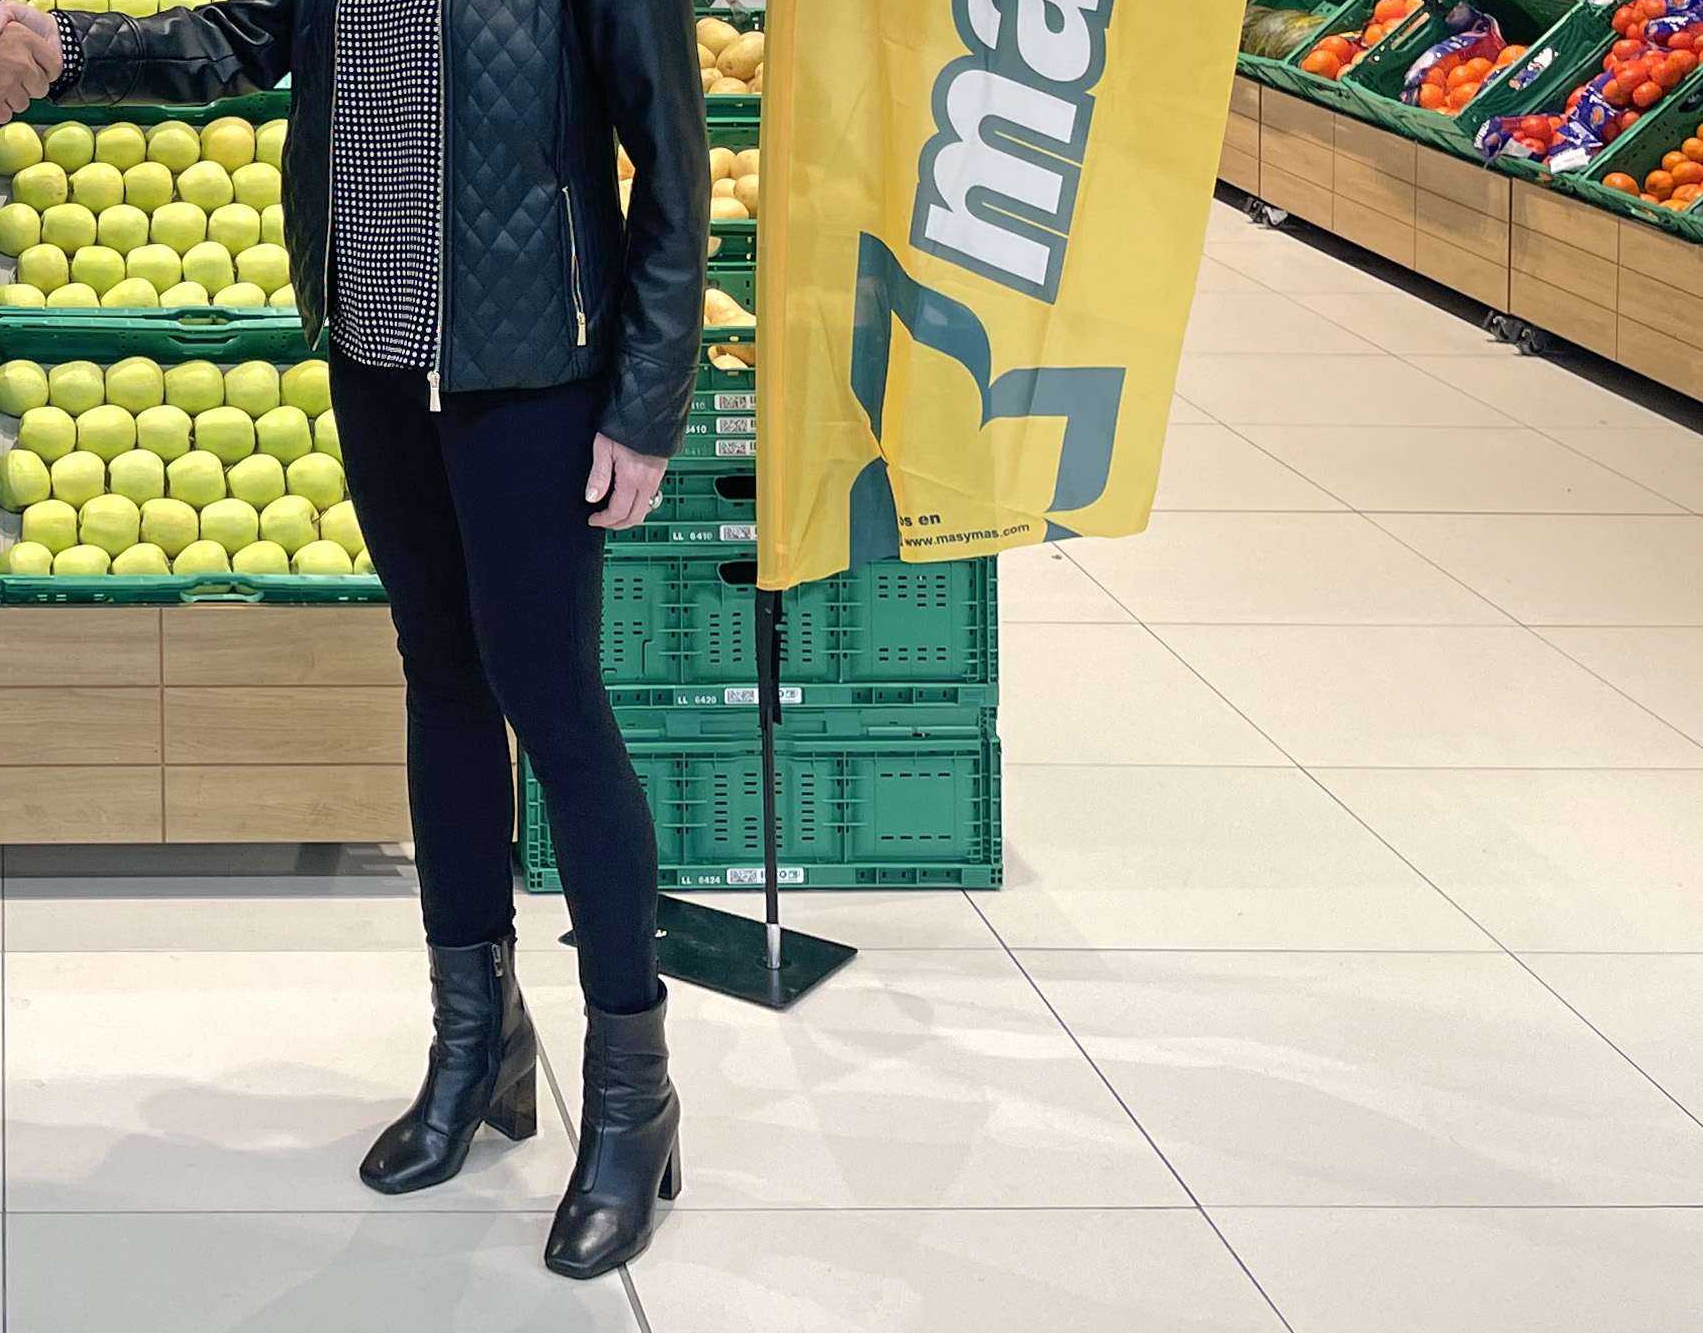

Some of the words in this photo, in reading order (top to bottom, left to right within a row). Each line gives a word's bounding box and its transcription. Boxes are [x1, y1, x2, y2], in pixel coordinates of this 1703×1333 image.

[918, 513, 942, 526] en
[672, 532, 684, 541] LL
[677, 695, 689, 705] LL
[694, 695, 717, 704] 6420
[681, 875, 693, 885] LL
